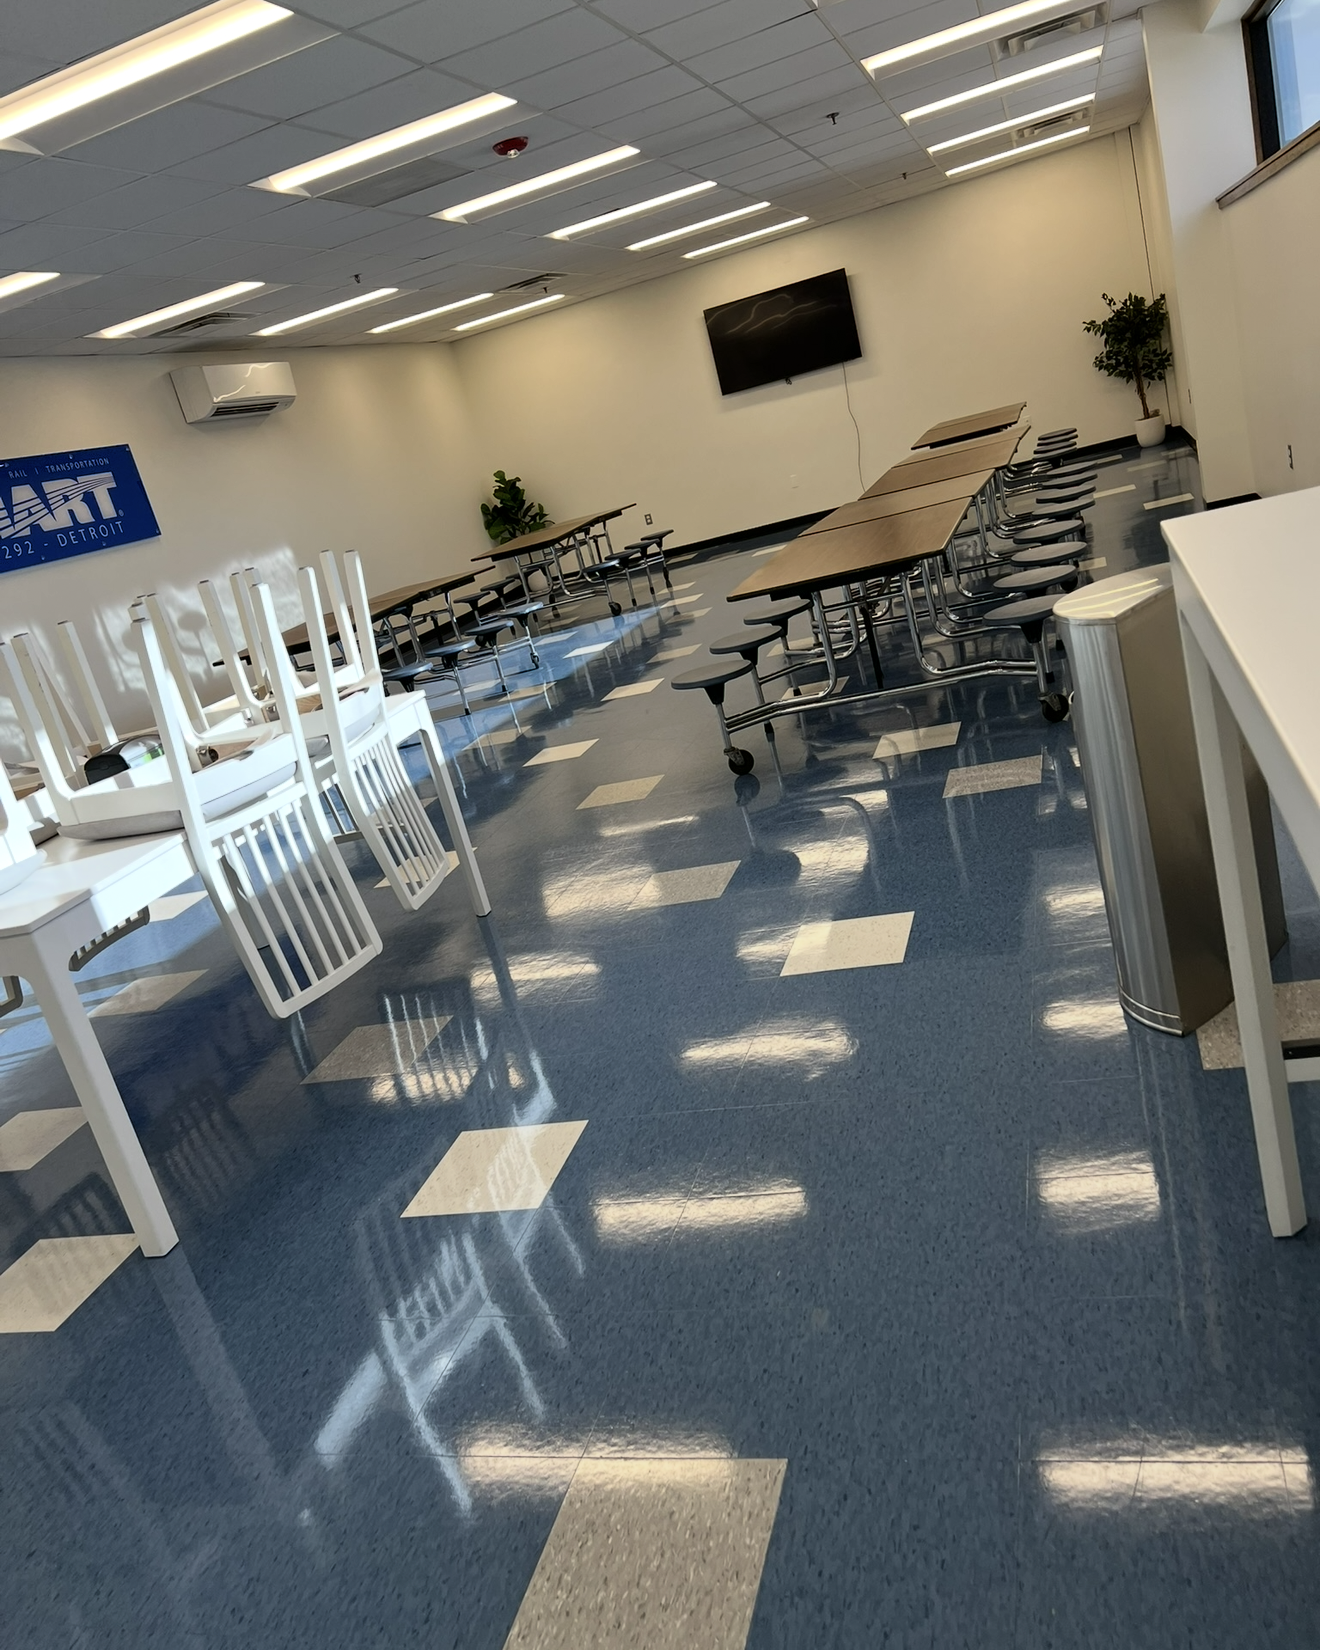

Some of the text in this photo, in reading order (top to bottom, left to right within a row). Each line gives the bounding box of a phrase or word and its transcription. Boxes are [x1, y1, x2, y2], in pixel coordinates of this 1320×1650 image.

[8, 469, 28, 479] RAIL
[45, 457, 110, 474] TRANSPORTATION
[1, 540, 35, 559] 292
[56, 521, 125, 547] DETROIT
